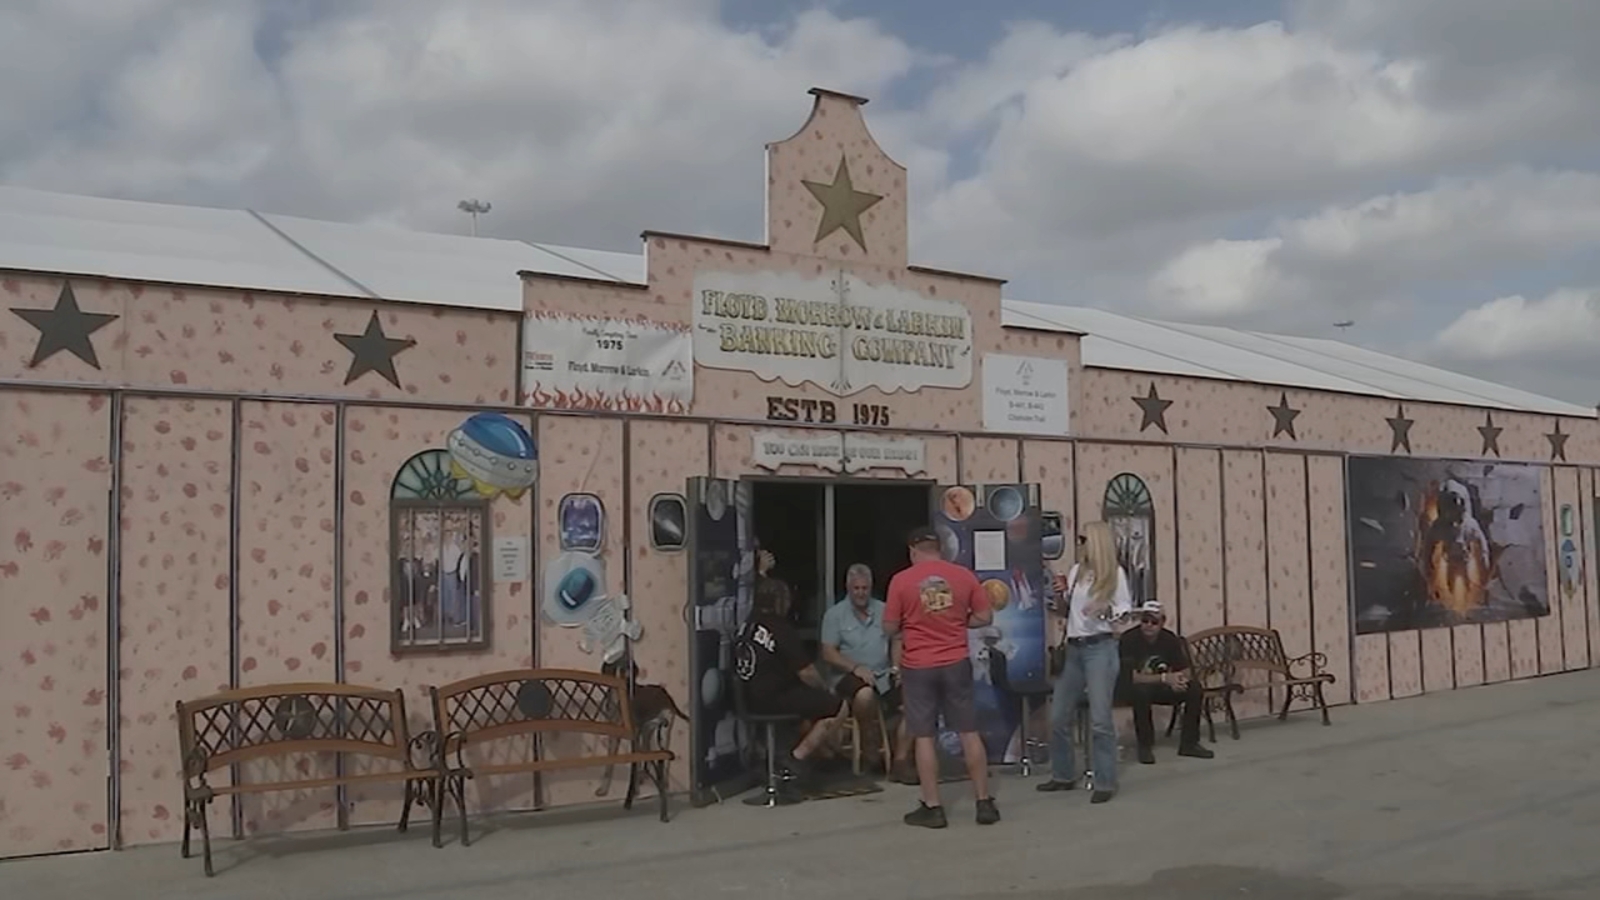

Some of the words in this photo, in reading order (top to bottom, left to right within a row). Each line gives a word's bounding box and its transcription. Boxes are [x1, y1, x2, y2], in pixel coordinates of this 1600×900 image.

[886, 308, 966, 339] LARKIN
[596, 339, 623, 350] 1975
[719, 323, 836, 358] BANKING
[852, 337, 956, 369] COMPANY
[766, 397, 837, 423] ESTB
[852, 403, 890, 426] 1975
